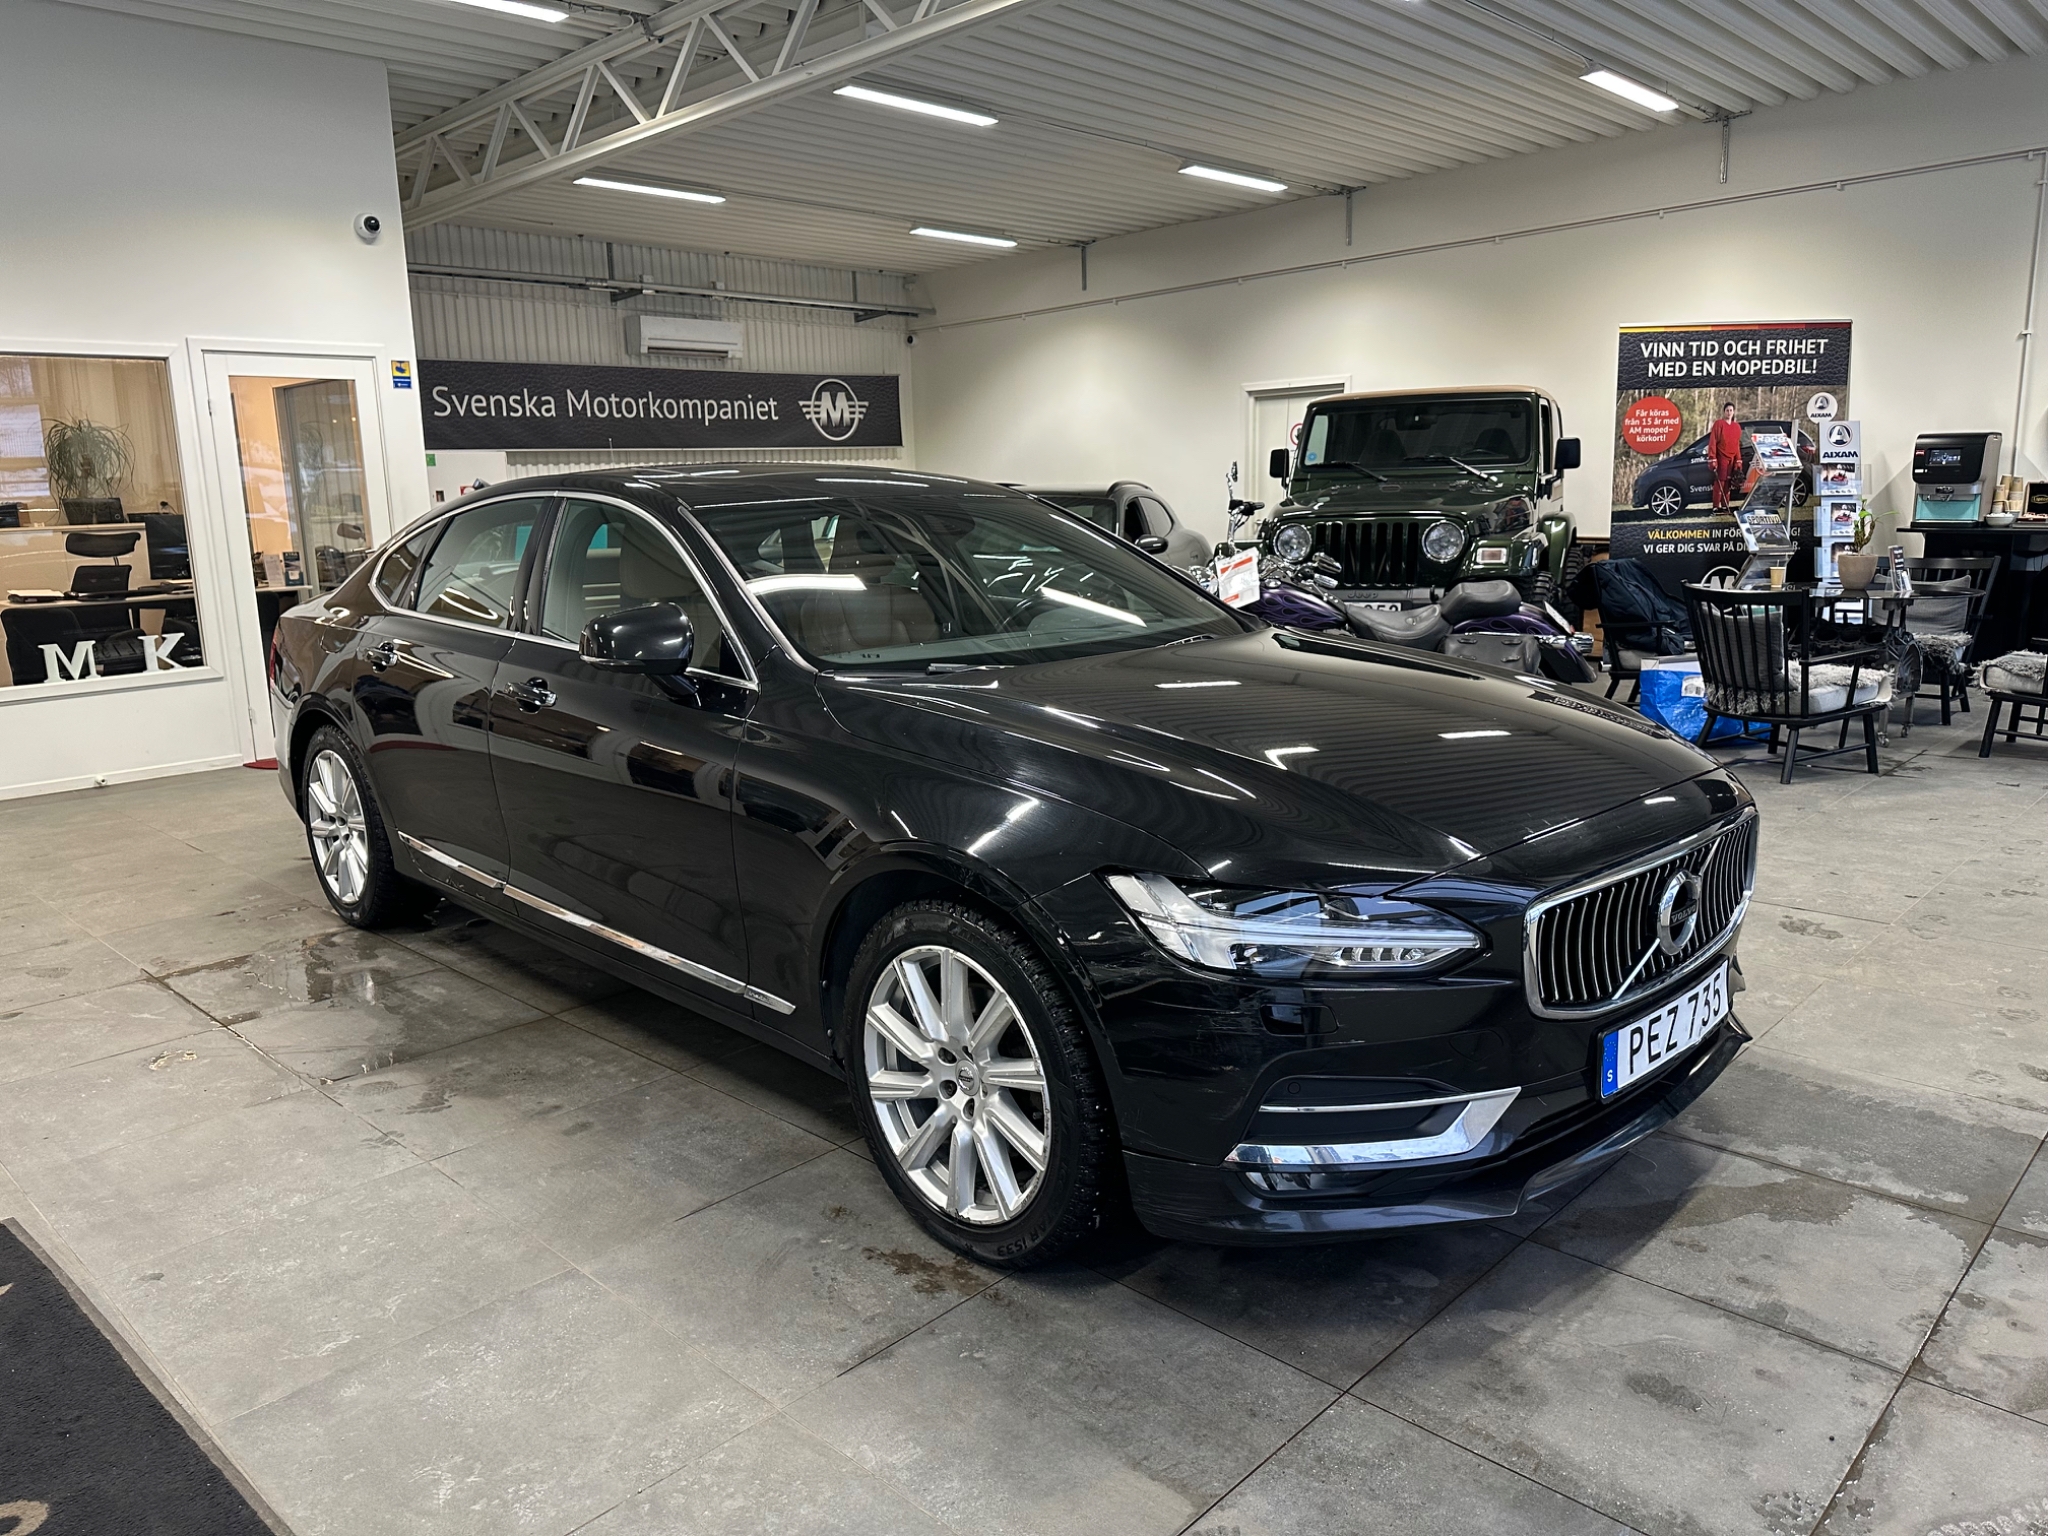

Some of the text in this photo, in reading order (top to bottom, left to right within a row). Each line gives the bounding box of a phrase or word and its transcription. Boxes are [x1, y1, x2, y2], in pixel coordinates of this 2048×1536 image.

[1640, 338, 1829, 358] VINN TID OCH FRIHET
[1648, 359, 1817, 378] MED EN MOPEDBIL!
[432, 386, 779, 426] Svenska Motorkompaniet
[1635, 408, 1669, 417] Får köras
[1624, 417, 1679, 426] från 15 år med
[1628, 426, 1642, 434] AM
[1636, 434, 1666, 442] körkort!
[1822, 450, 1859, 459] AIXAM
[1647, 528, 1710, 540] VÄLKOMMEN
[1712, 529, 1722, 538] IN
[1643, 544, 1654, 554] VI
[1655, 543, 1675, 554] GER
[1677, 543, 1695, 553] DIG
[1697, 542, 1721, 552] SVAR
[1722, 541, 1735, 552] PÅ
[38, 632, 187, 683] M K
[1670, 904, 1697, 923] VOLVO
[1629, 972, 1721, 1075] PEZ 735
[1606, 1069, 1613, 1083] S
